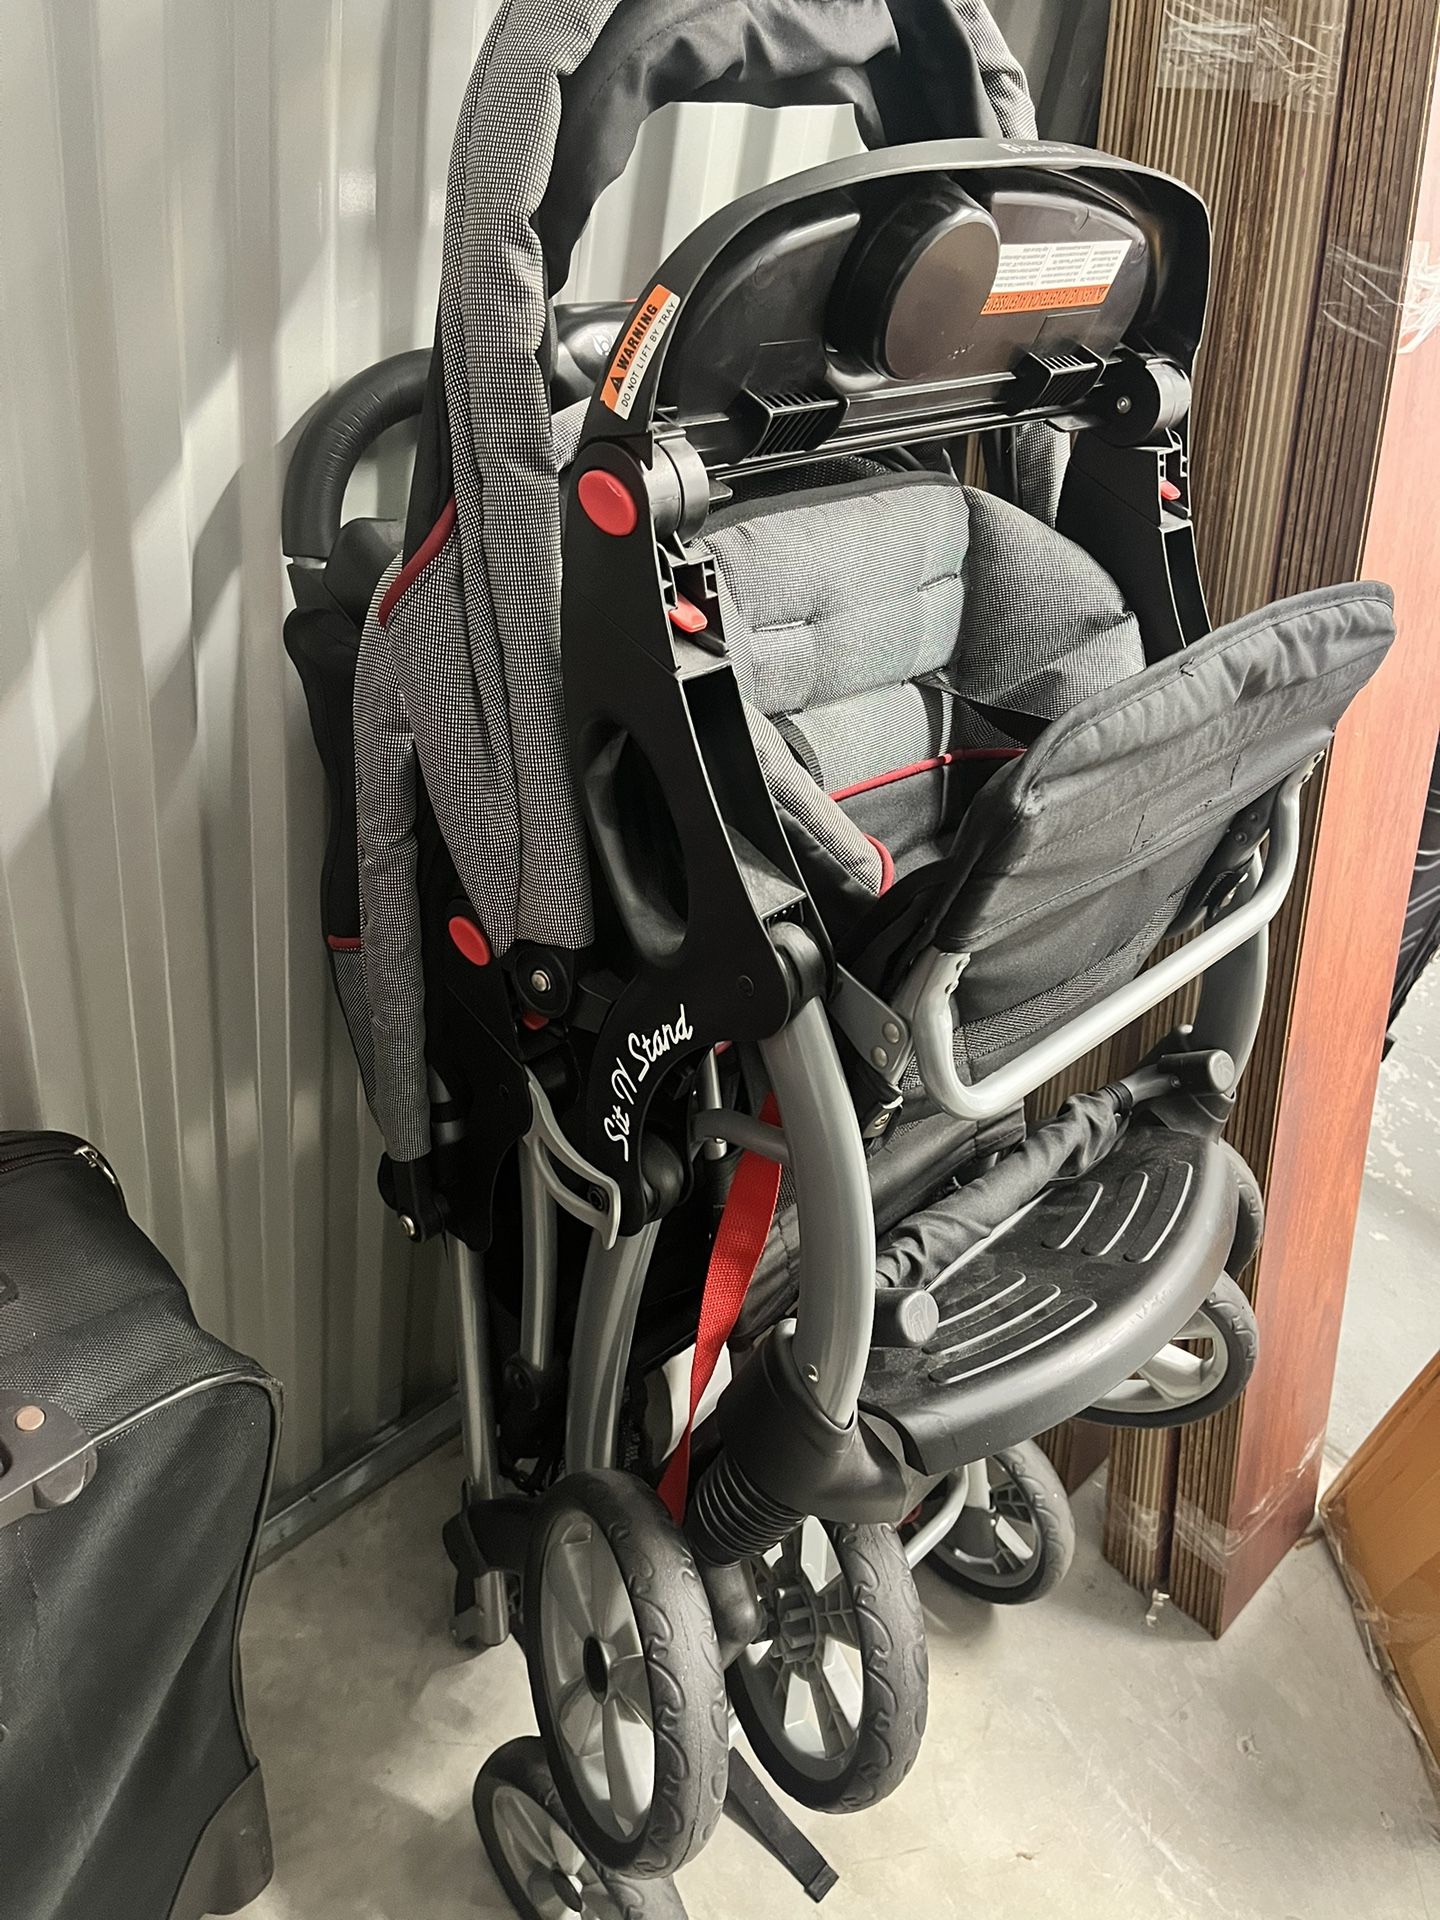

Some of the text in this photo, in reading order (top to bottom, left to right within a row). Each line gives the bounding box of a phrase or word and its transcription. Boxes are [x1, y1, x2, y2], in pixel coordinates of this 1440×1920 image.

[617, 303, 658, 371] WARNING
[621, 302, 676, 408] DO NOT LIFT BY TRAY
[604, 1003, 693, 1162] Sit N Stand
